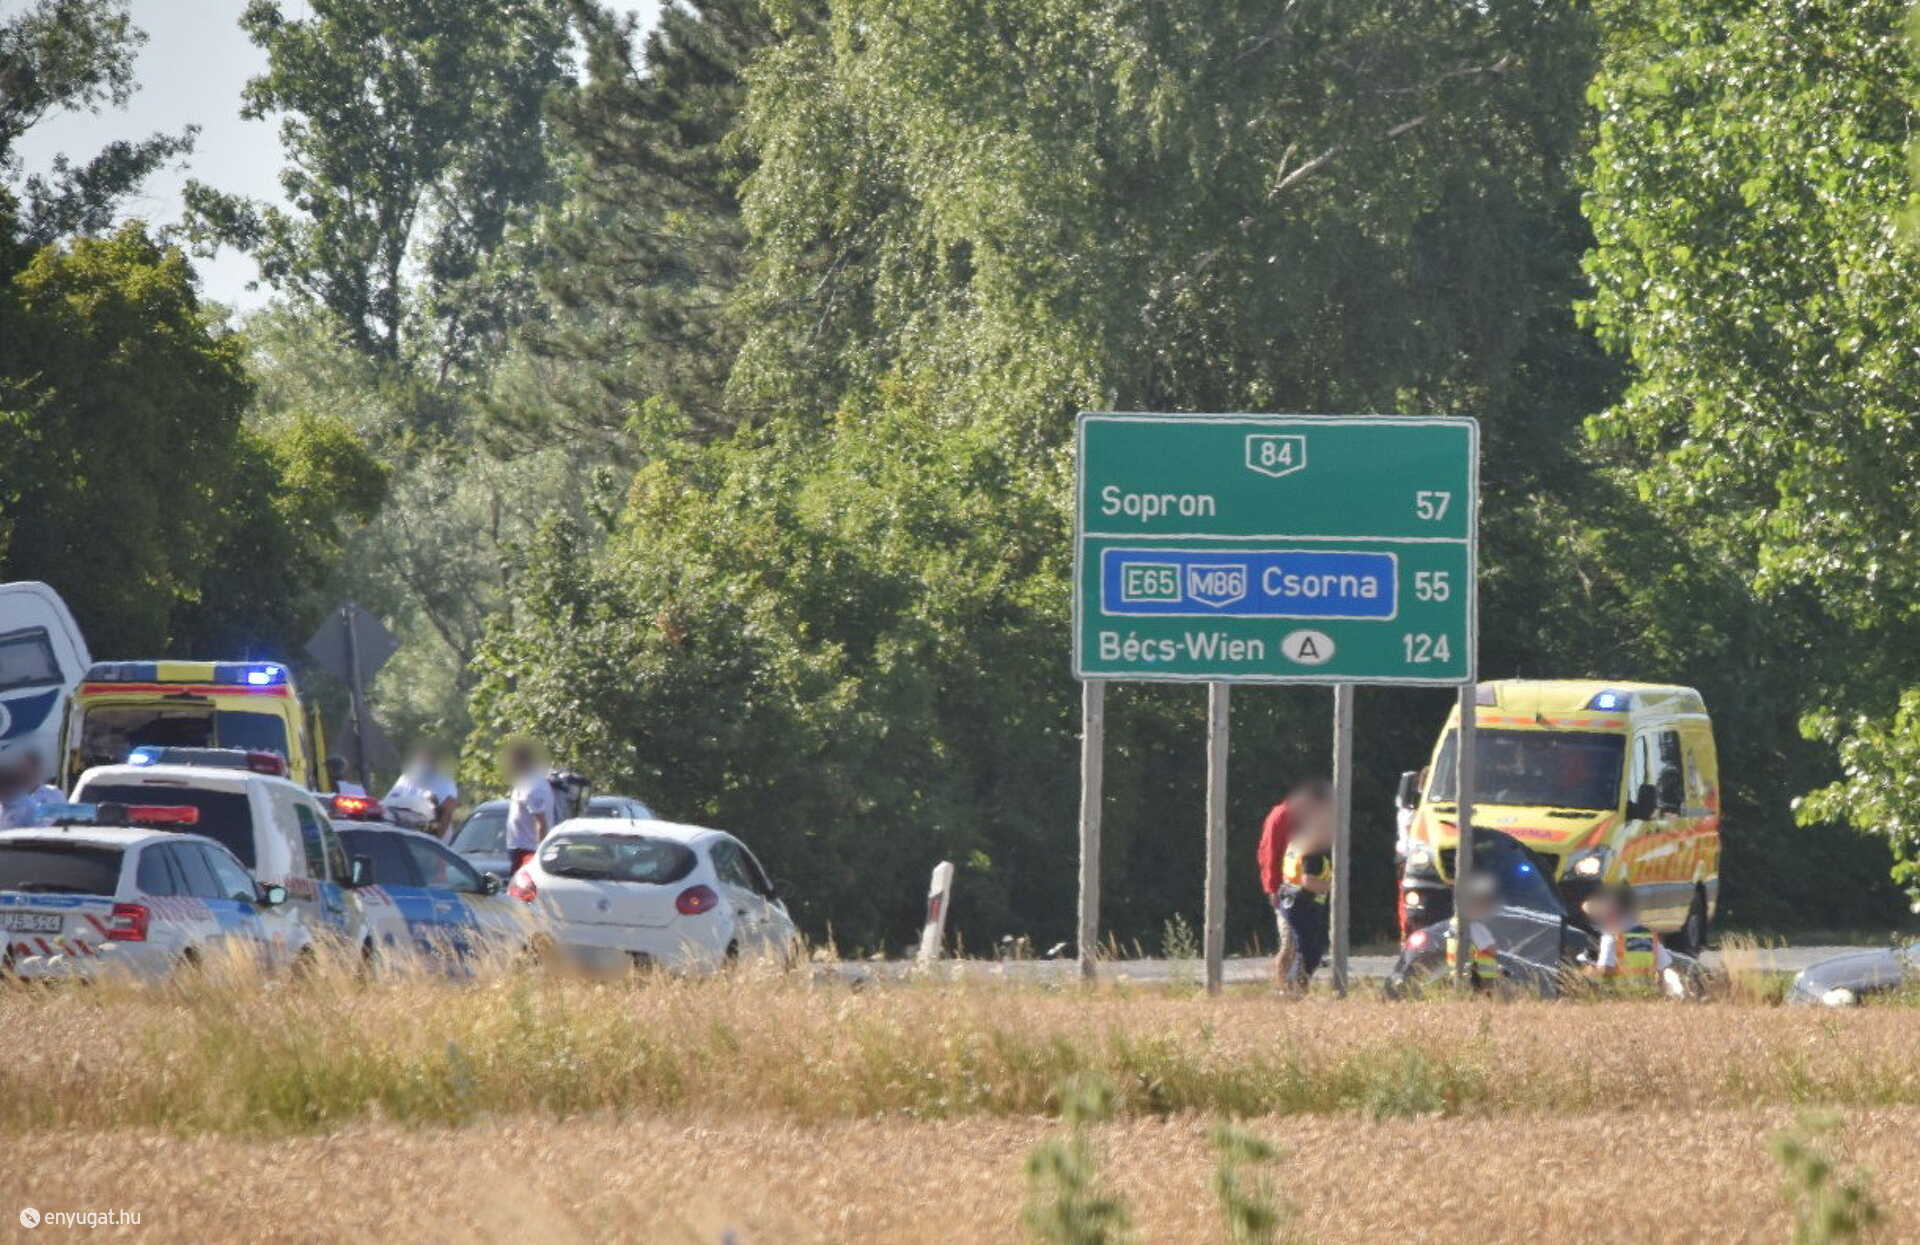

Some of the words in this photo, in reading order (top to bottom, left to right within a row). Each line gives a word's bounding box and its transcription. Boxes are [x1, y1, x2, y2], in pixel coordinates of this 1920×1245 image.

[1260, 442, 1292, 466] 84
[1101, 485, 1216, 522] Sopron
[1416, 490, 1451, 521] 57
[1128, 570, 1174, 596] E65
[1191, 572, 1242, 595] M86
[1262, 566, 1378, 599] Csorna
[1414, 571, 1450, 602] 55
[1099, 630, 1265, 662] Bécs-Wien
[1297, 636, 1320, 659] A
[1403, 633, 1451, 663] 124
